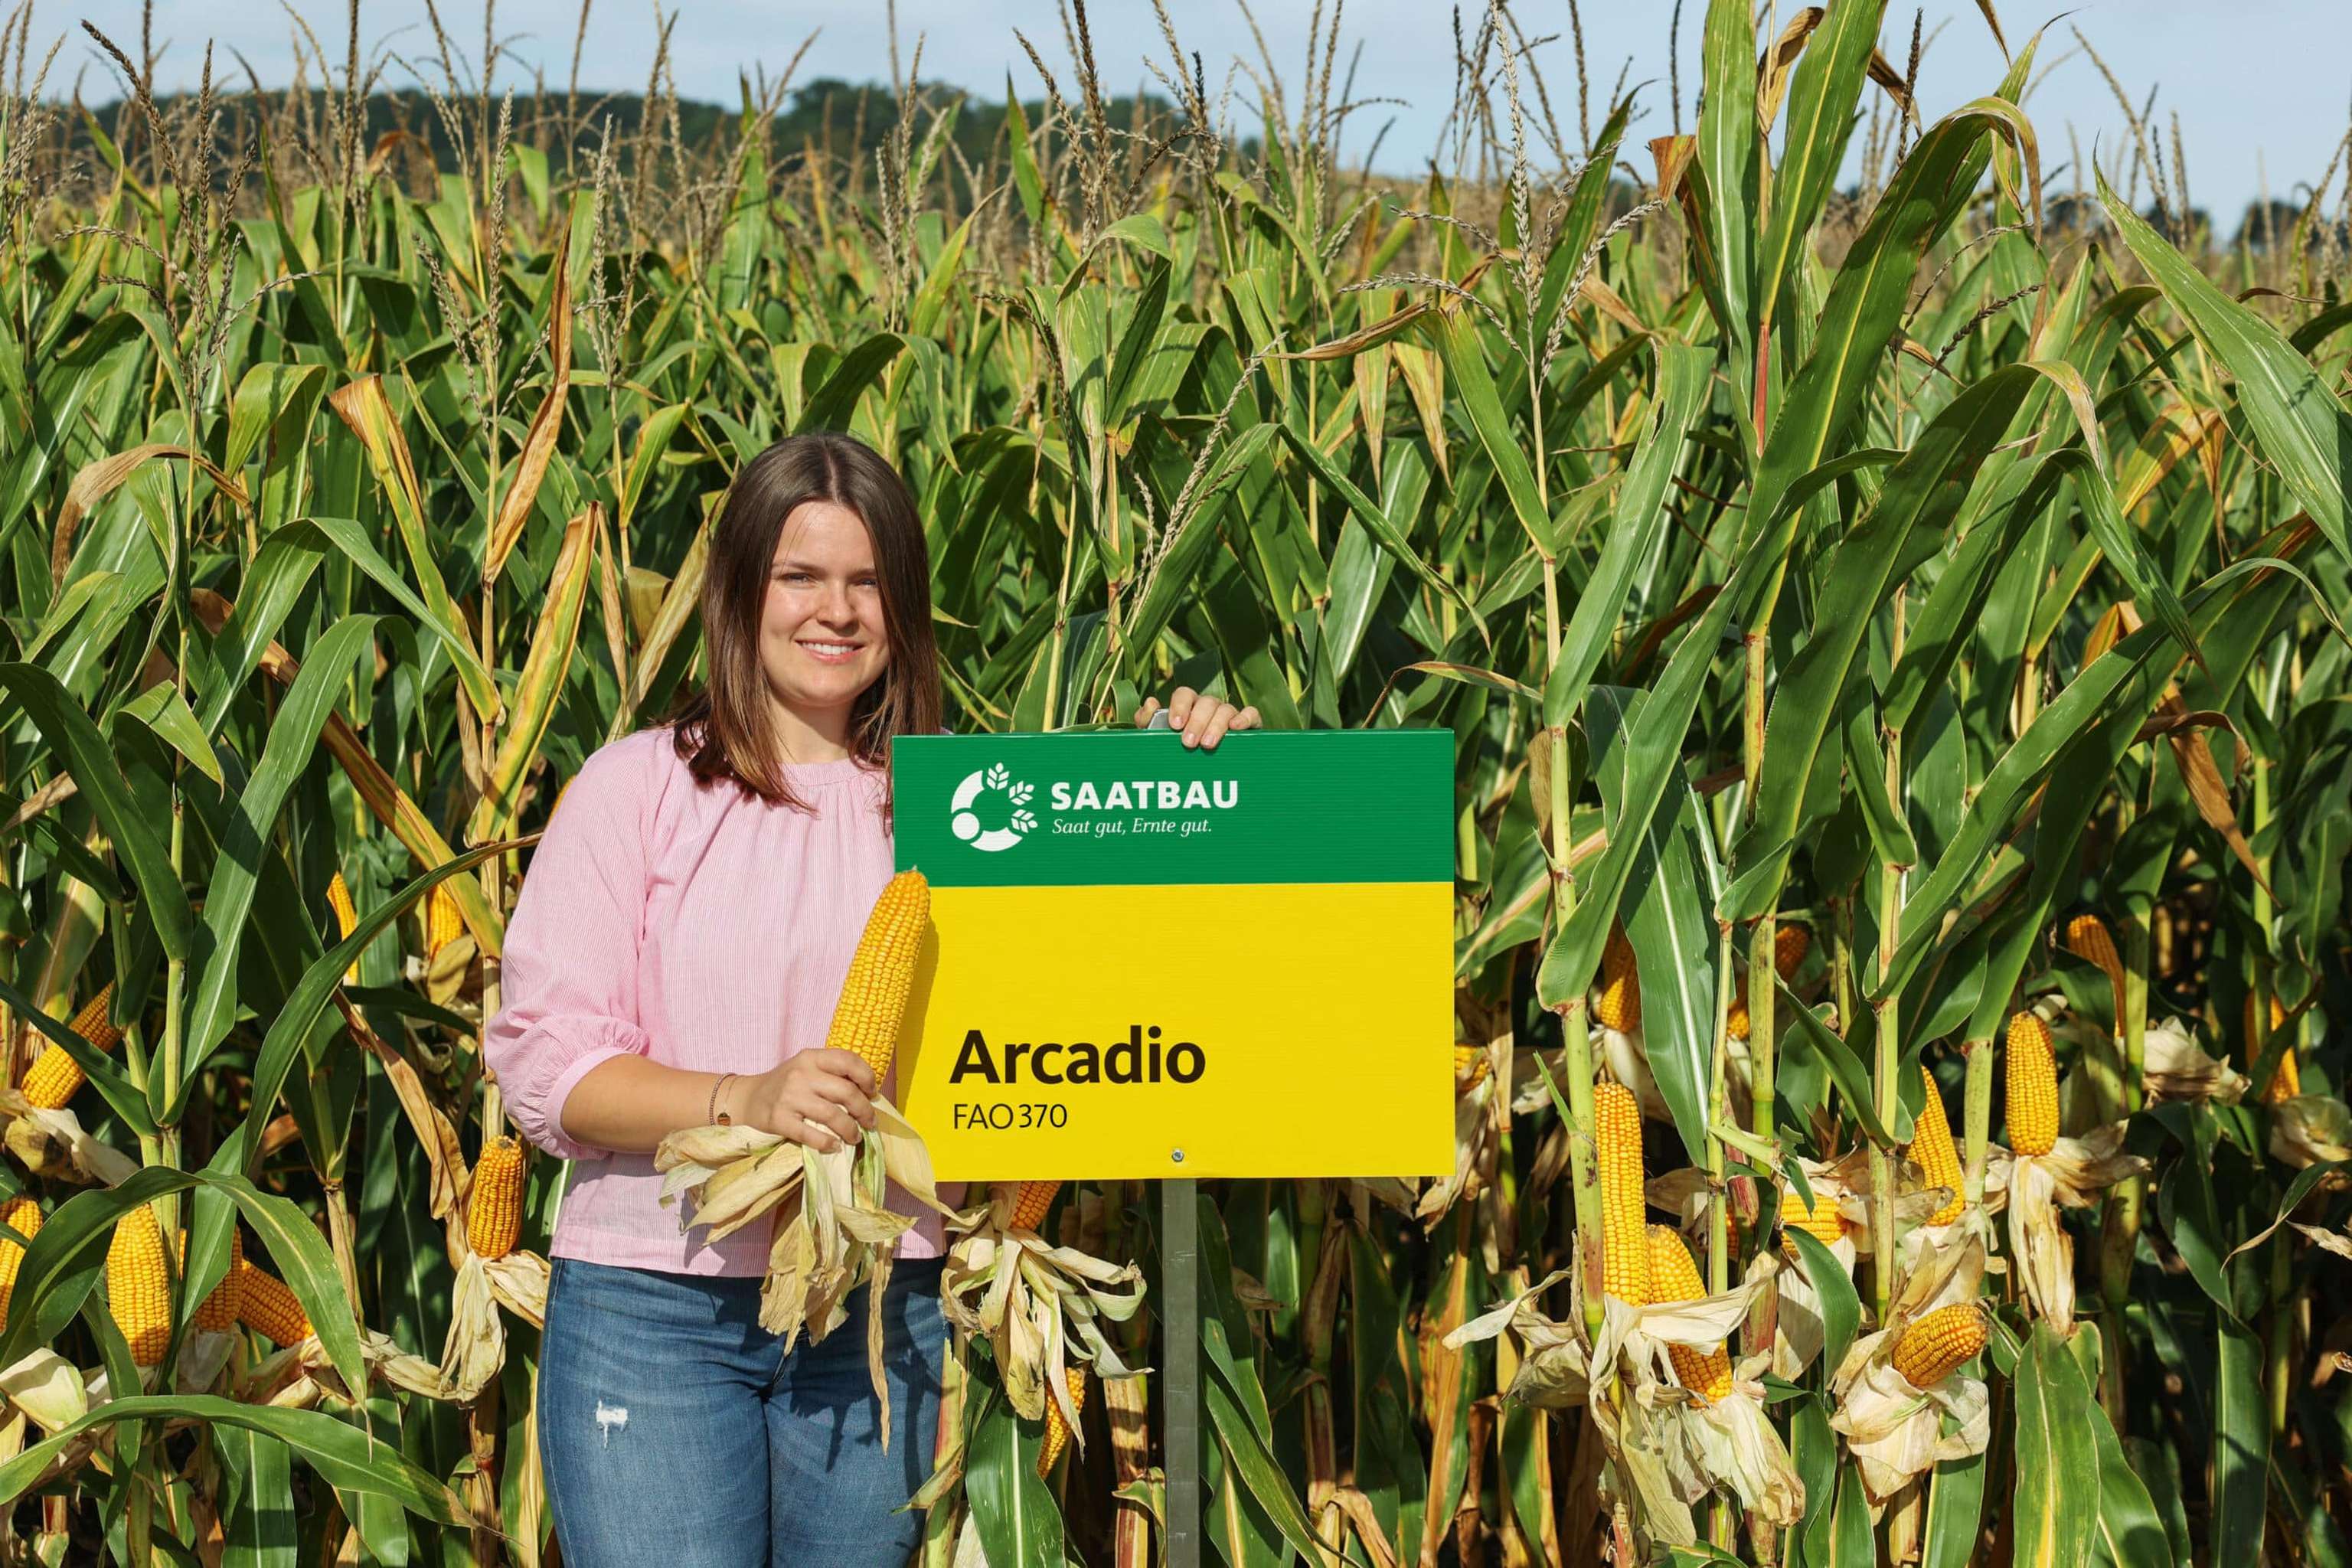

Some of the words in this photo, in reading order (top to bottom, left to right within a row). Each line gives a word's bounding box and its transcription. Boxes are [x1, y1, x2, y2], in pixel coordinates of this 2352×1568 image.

[1051, 780, 1238, 811] SAATBAU
[1052, 818, 1089, 834] Saat
[1095, 821, 1127, 837] gut,
[1132, 818, 1176, 833] Ernte
[1181, 819, 1212, 837] gut.
[949, 1024, 1206, 1085] Arcadio
